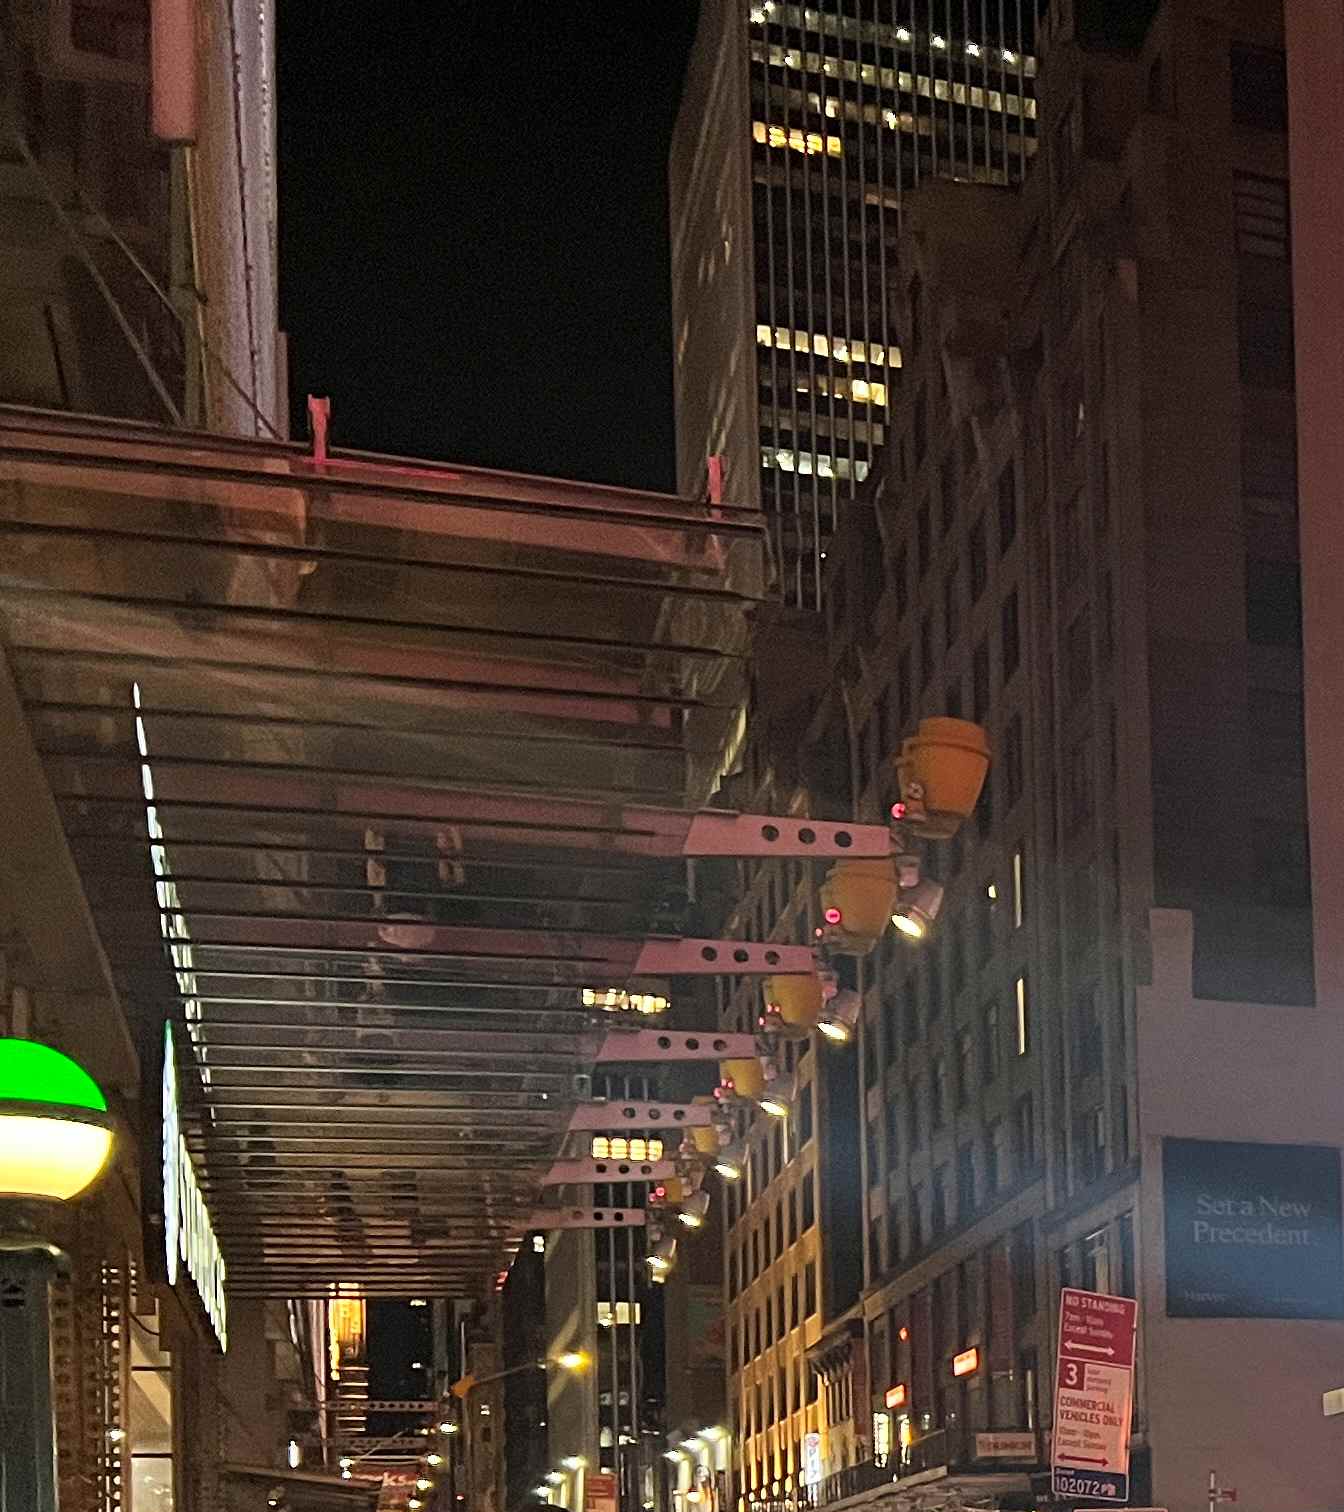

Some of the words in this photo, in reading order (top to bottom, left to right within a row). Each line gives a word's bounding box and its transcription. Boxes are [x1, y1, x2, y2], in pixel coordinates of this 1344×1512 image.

[1257, 1195, 1314, 1217] New
[1065, 1362, 1078, 1385] 3
[1060, 1409, 1101, 1425] VEHICLES
[1055, 1476, 1101, 1496] 102072
